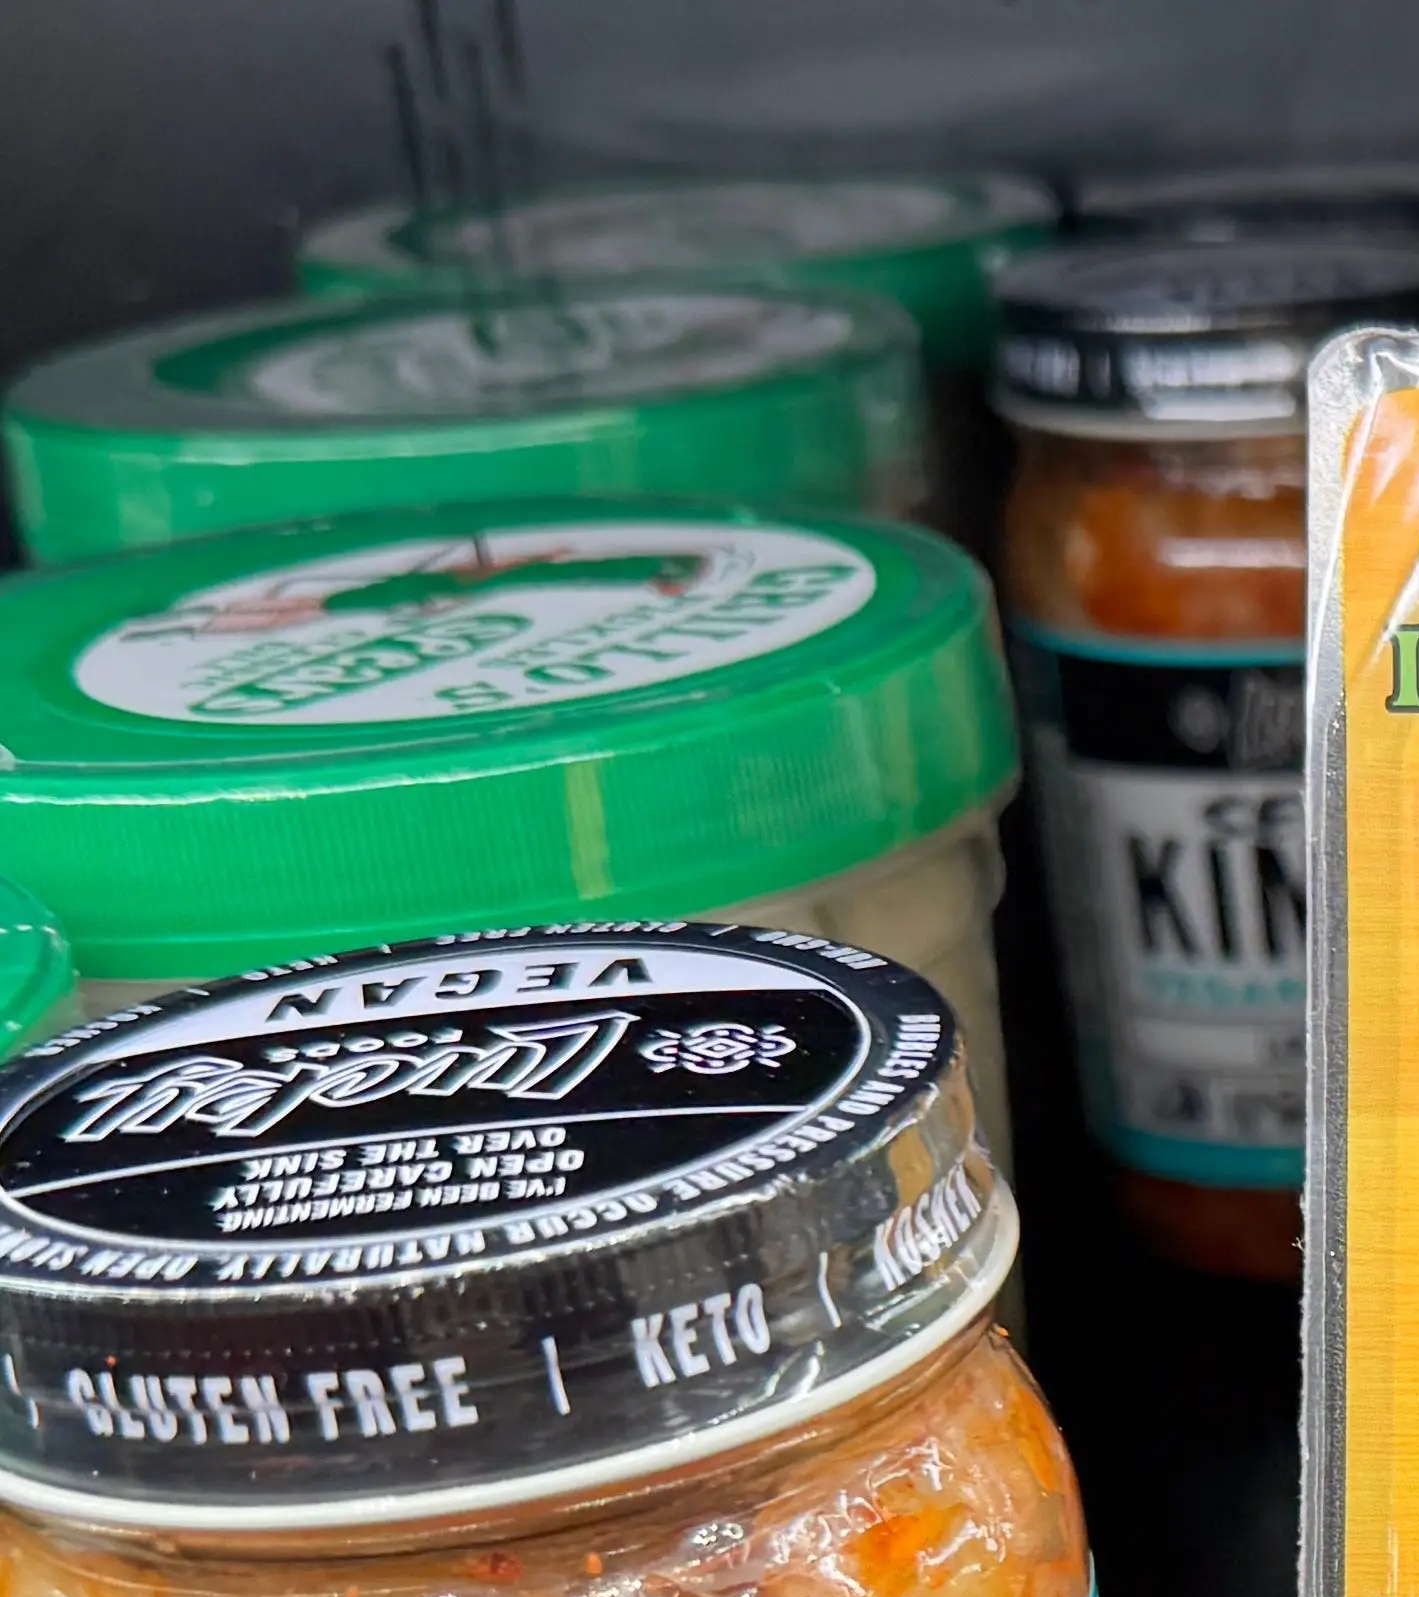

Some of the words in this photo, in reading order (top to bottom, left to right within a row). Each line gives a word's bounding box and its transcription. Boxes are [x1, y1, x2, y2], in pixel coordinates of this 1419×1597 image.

[265, 957, 654, 1022] VEGAN
[263, 1027, 465, 1062] FOODS
[888, 1013, 942, 1079] BUBBLES
[63, 1008, 640, 1142] Lucky
[243, 1148, 347, 1181] SINK
[357, 1138, 439, 1168] THE
[453, 1127, 566, 1154] OVER
[468, 1148, 585, 1181] OPEN
[679, 1109, 857, 1202] PRESSURE
[212, 1160, 453, 1213] CAREFULLY
[213, 1190, 414, 1233] FERMENTING
[420, 1180, 500, 1208] BEEN
[503, 1191, 658, 1248] OCCUR
[630, 1282, 771, 1389] KETO
[66, 1368, 291, 1443] GLUTEN
[306, 1356, 479, 1440] FREE
